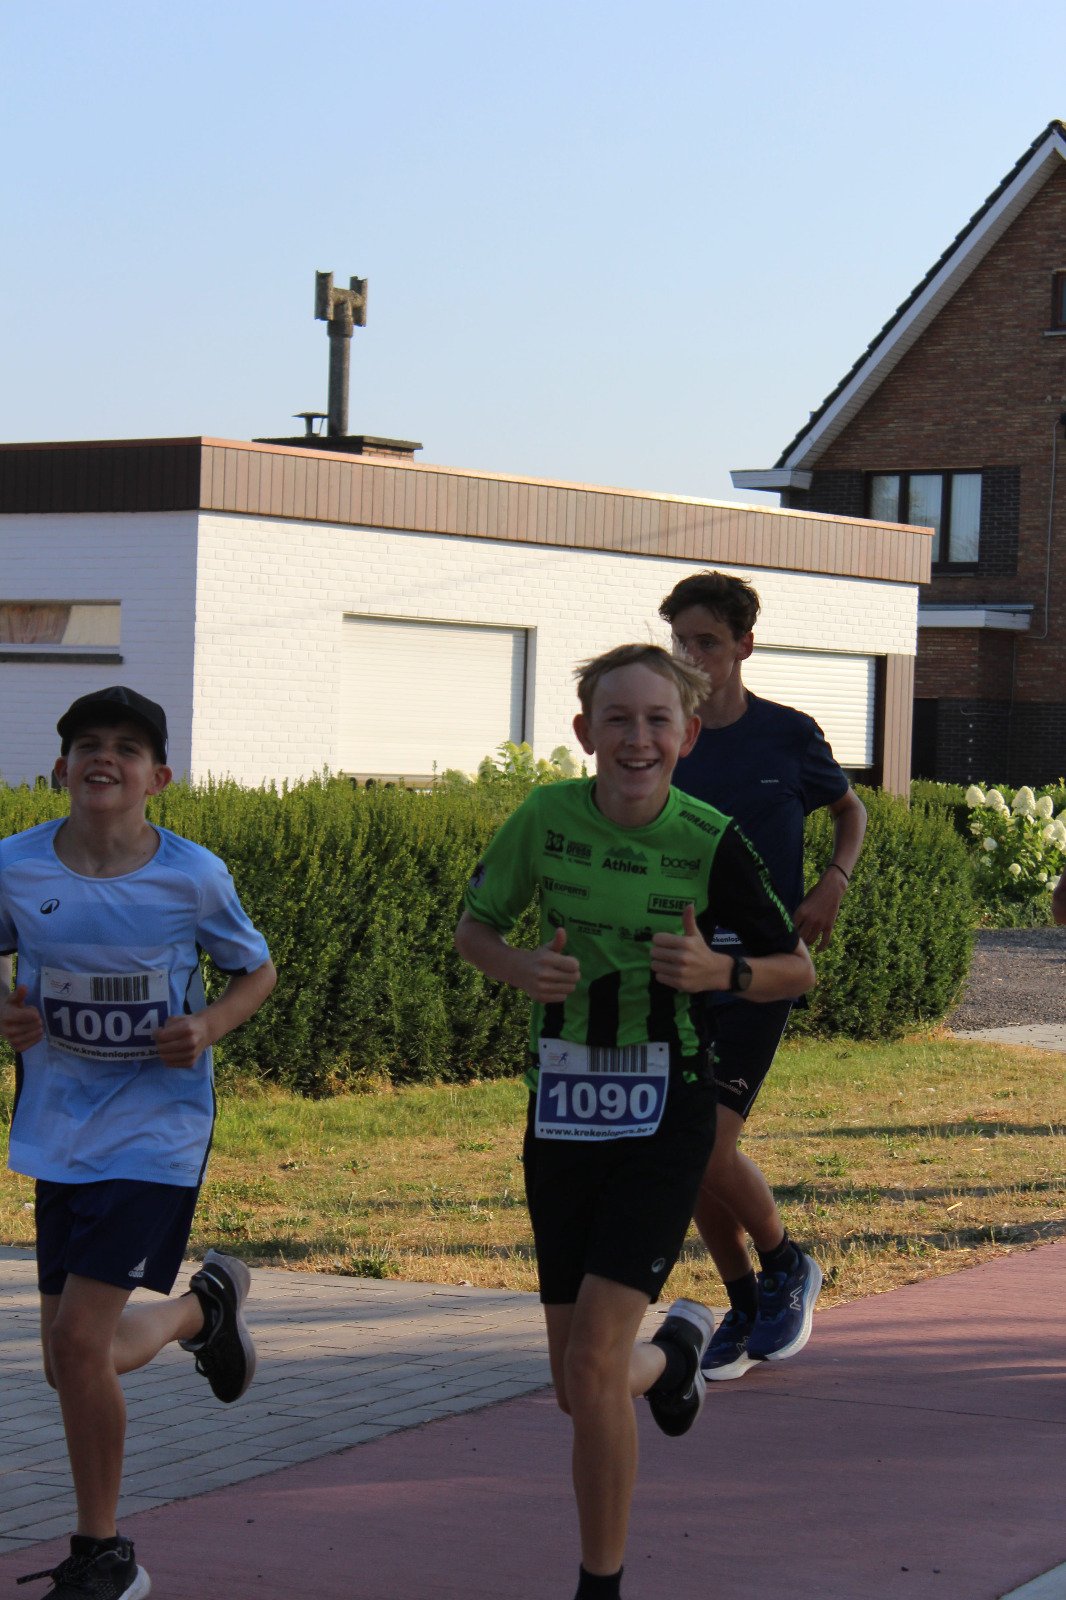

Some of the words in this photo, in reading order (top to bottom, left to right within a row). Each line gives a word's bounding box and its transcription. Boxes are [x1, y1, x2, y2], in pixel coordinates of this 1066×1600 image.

[602, 857, 648, 875] Athlex
[52, 1006, 160, 1042] 1004
[548, 1080, 658, 1120] 1090
